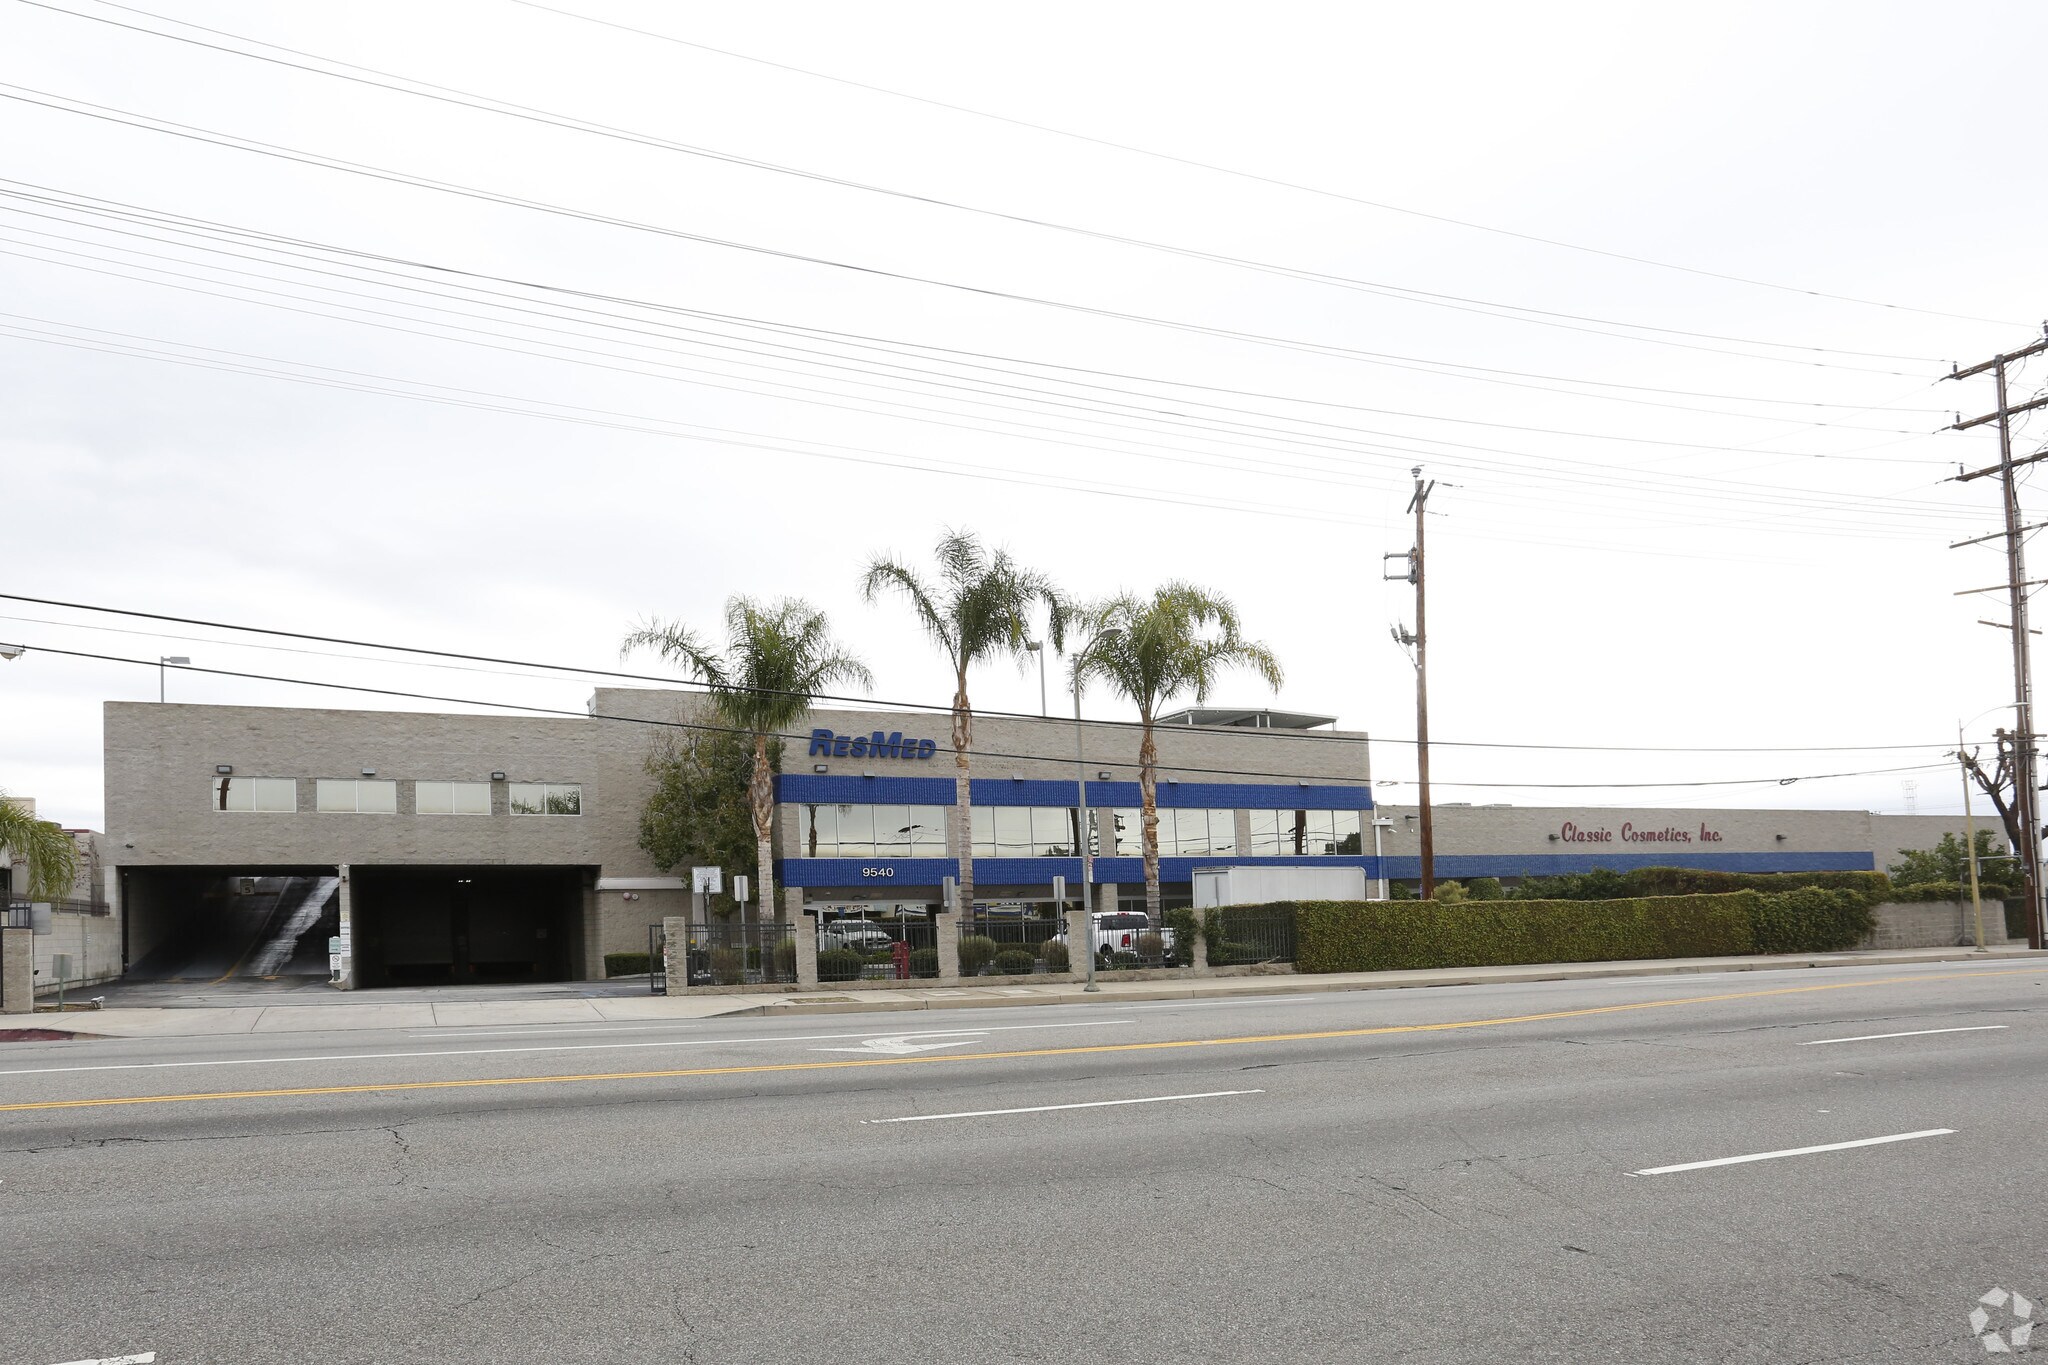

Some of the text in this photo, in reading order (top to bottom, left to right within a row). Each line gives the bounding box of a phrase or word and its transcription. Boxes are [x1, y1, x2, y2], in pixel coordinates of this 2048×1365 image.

[1561, 821, 1723, 843] Classic Cosmetics, Inc.
[862, 867, 894, 877] 9540
